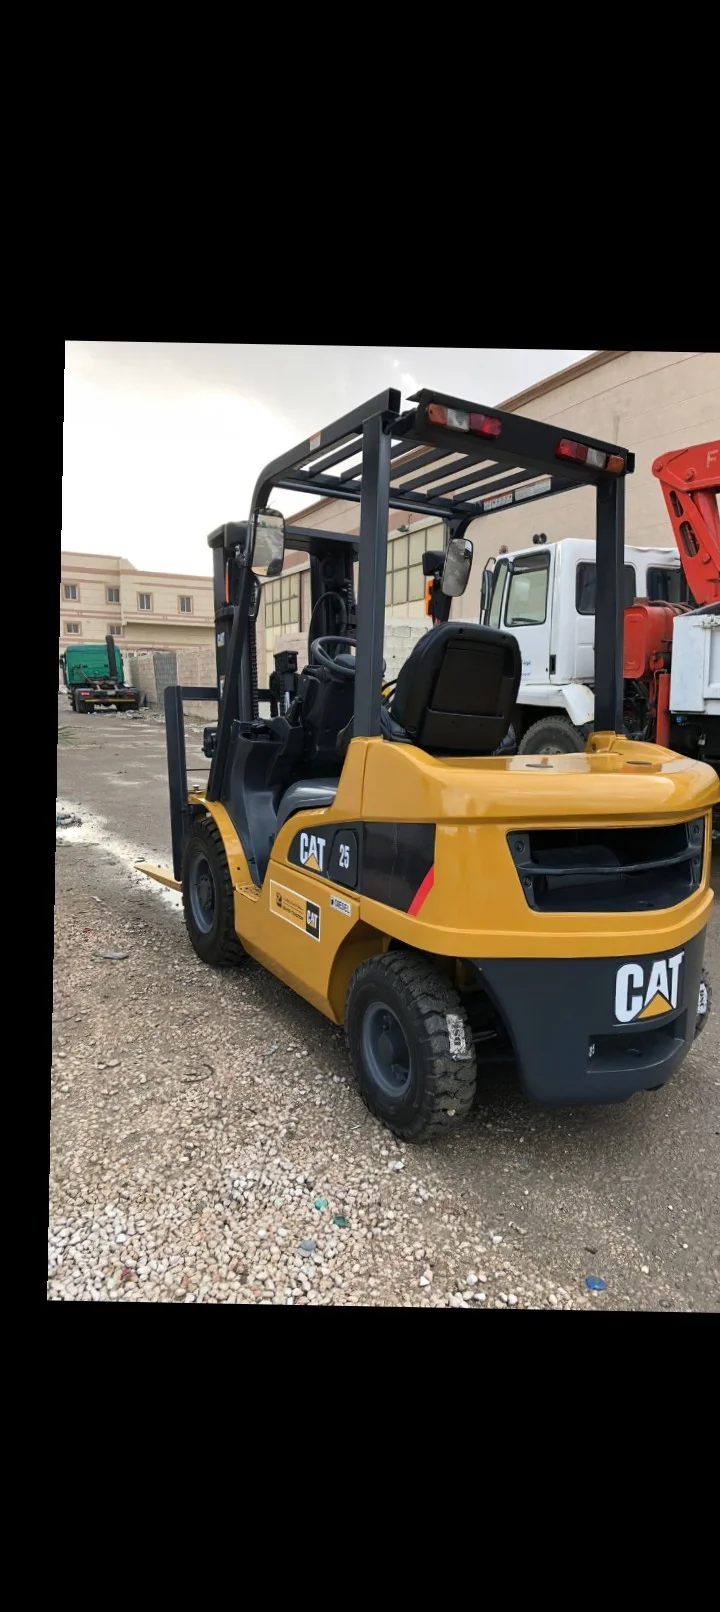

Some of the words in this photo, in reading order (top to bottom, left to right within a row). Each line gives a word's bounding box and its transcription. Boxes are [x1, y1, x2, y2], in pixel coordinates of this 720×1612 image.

[299, 832, 326, 872] CAT
[339, 843, 350, 869] 25
[307, 910, 318, 929] CAT
[334, 899, 350, 914] DIESEL
[614, 950, 685, 1023] CAT
